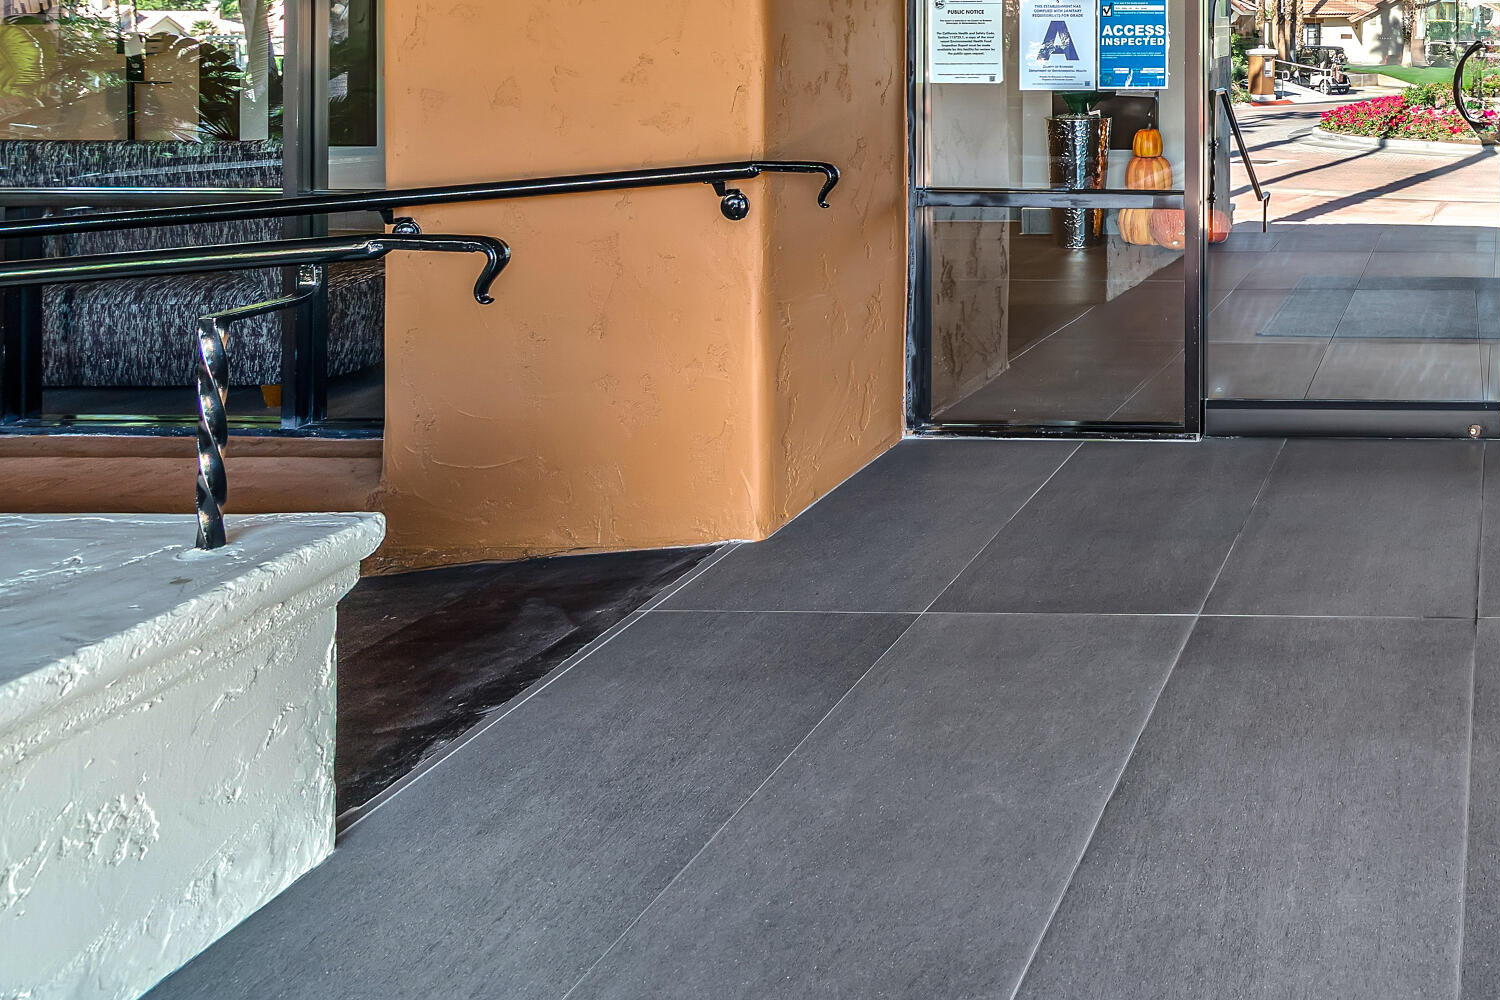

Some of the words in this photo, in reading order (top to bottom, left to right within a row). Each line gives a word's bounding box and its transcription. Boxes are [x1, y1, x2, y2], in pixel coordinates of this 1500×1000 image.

[1101, 24, 1165, 37] ACCESS
[1036, 20, 1080, 61] A
[1101, 37, 1165, 46] INSPECTED
